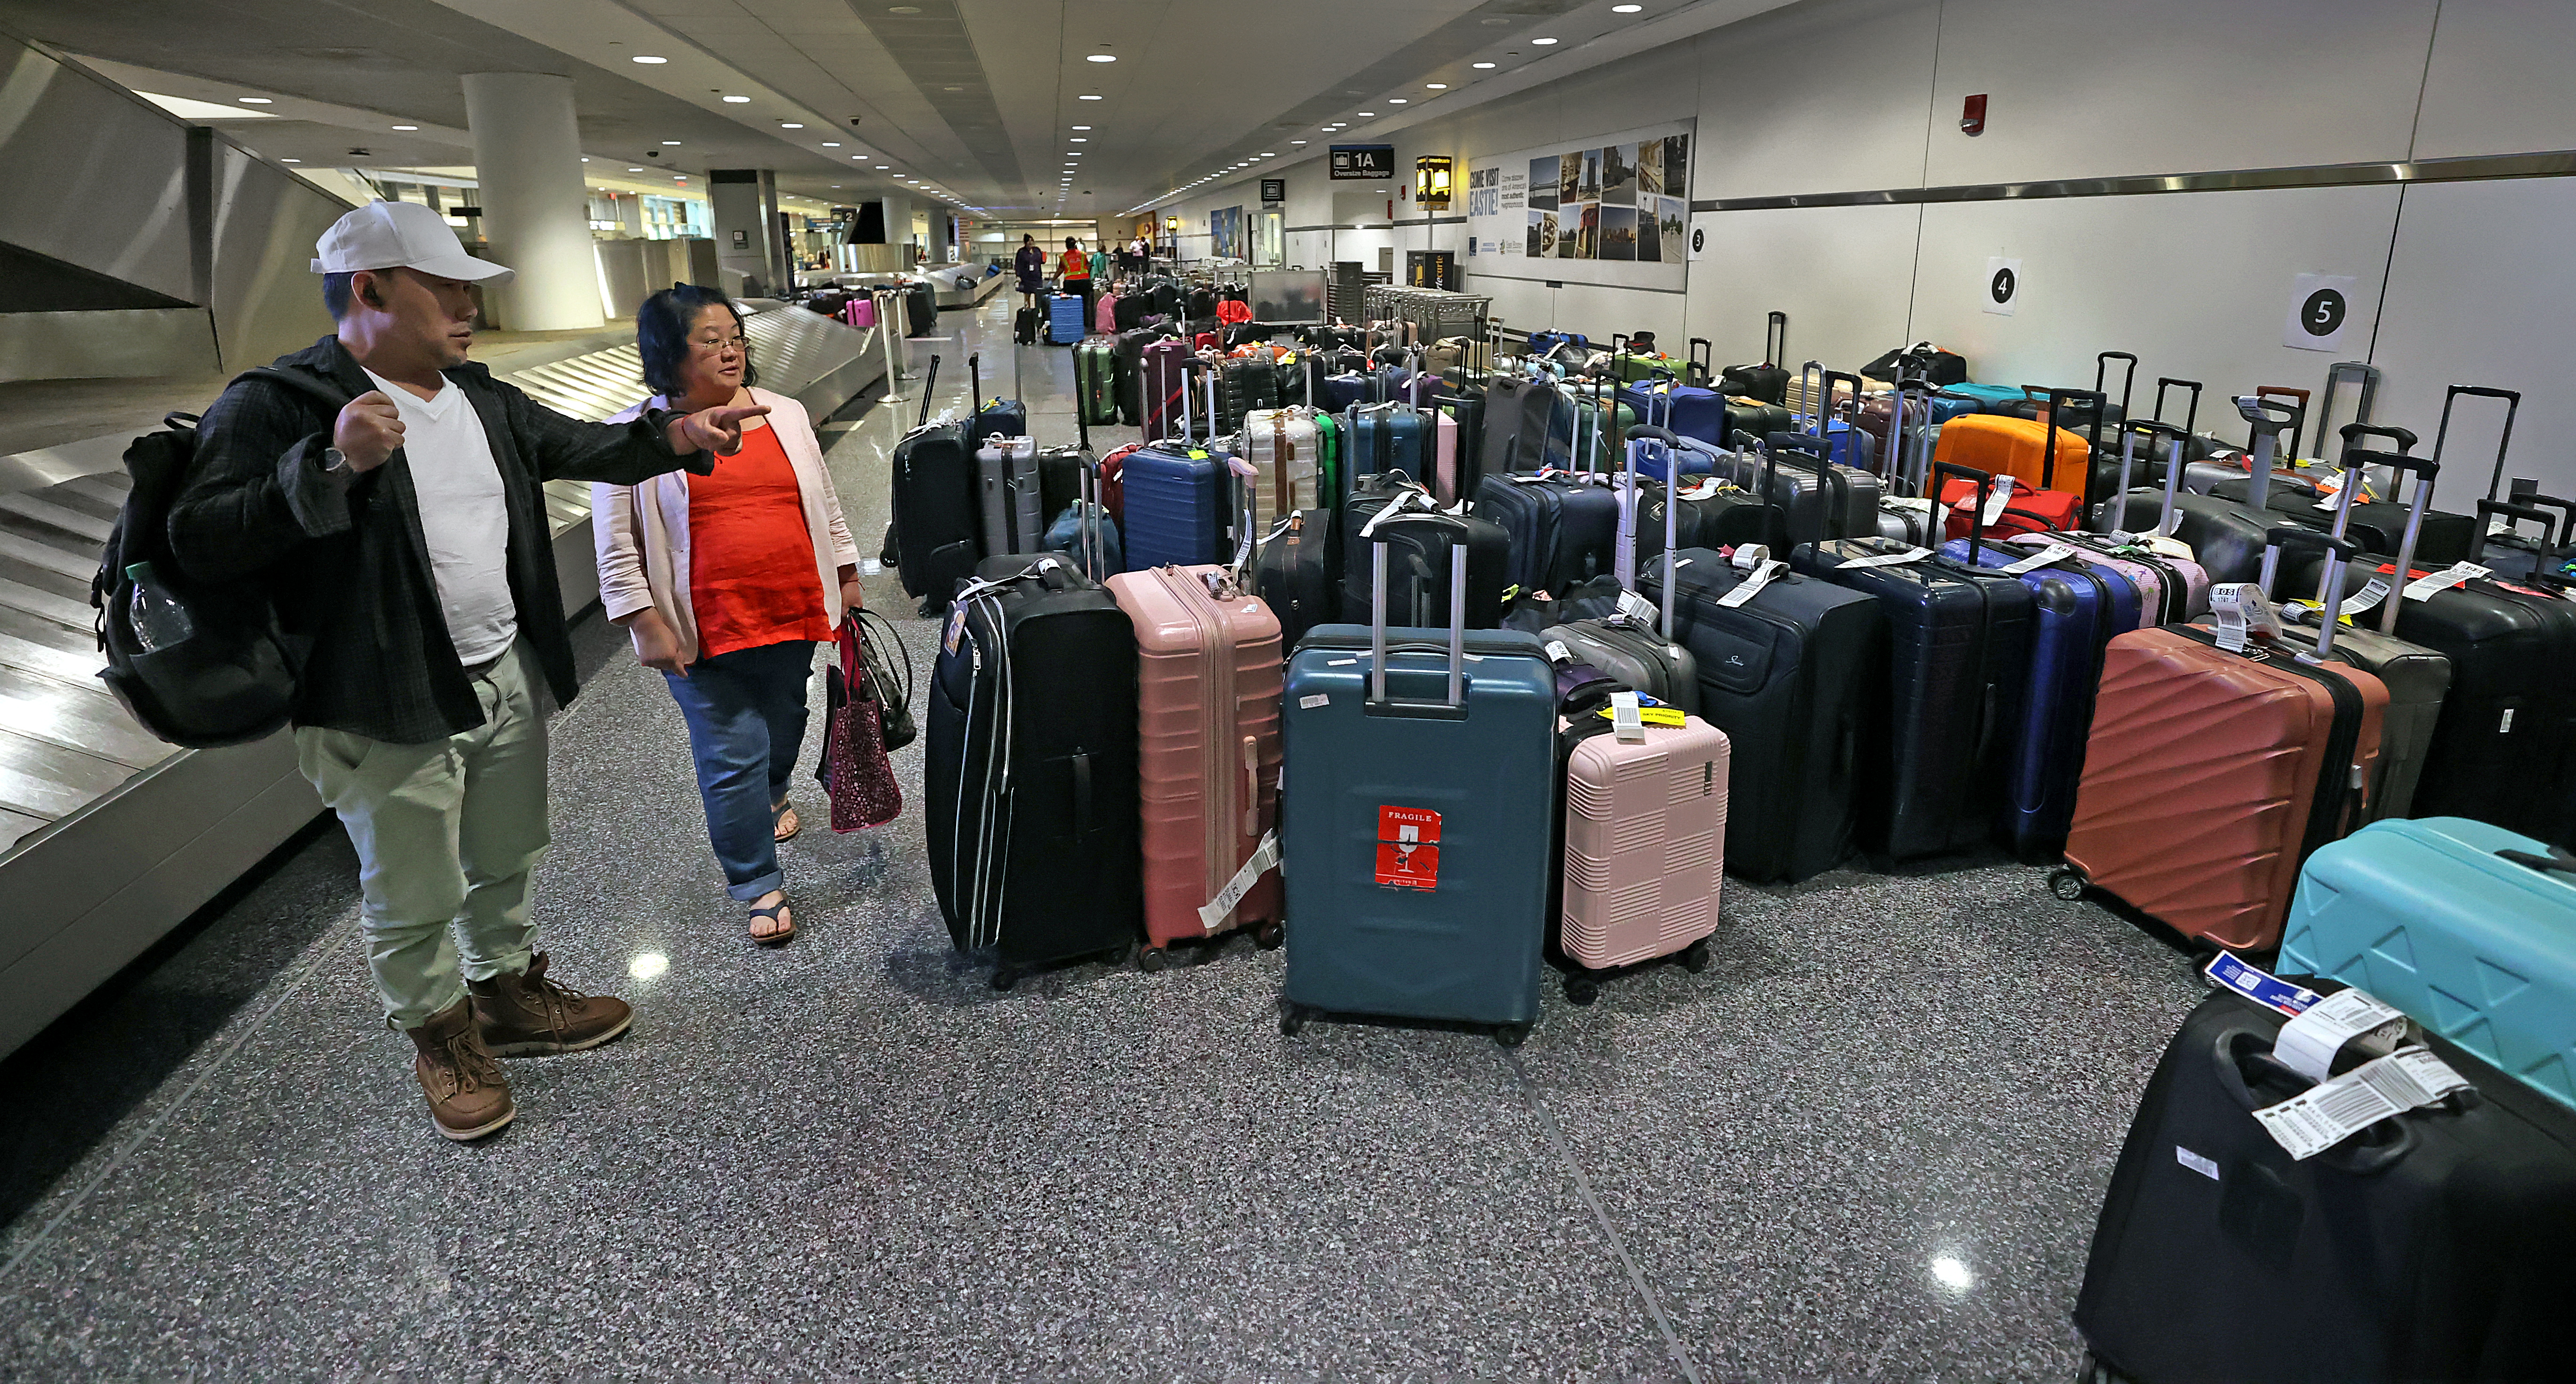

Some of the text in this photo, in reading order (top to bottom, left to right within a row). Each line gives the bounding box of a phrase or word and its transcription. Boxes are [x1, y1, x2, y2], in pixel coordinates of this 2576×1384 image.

[1355, 153, 1375, 167] 1A
[1470, 167, 1499, 189] COME VISIT
[1470, 188, 1498, 217] EASTIE!
[846, 212, 852, 221] 2
[1696, 235, 1700, 247] 3
[1998, 277, 2007, 294] 4
[2315, 301, 2333, 323] 5
[1389, 812, 1432, 822] FRAGILE
